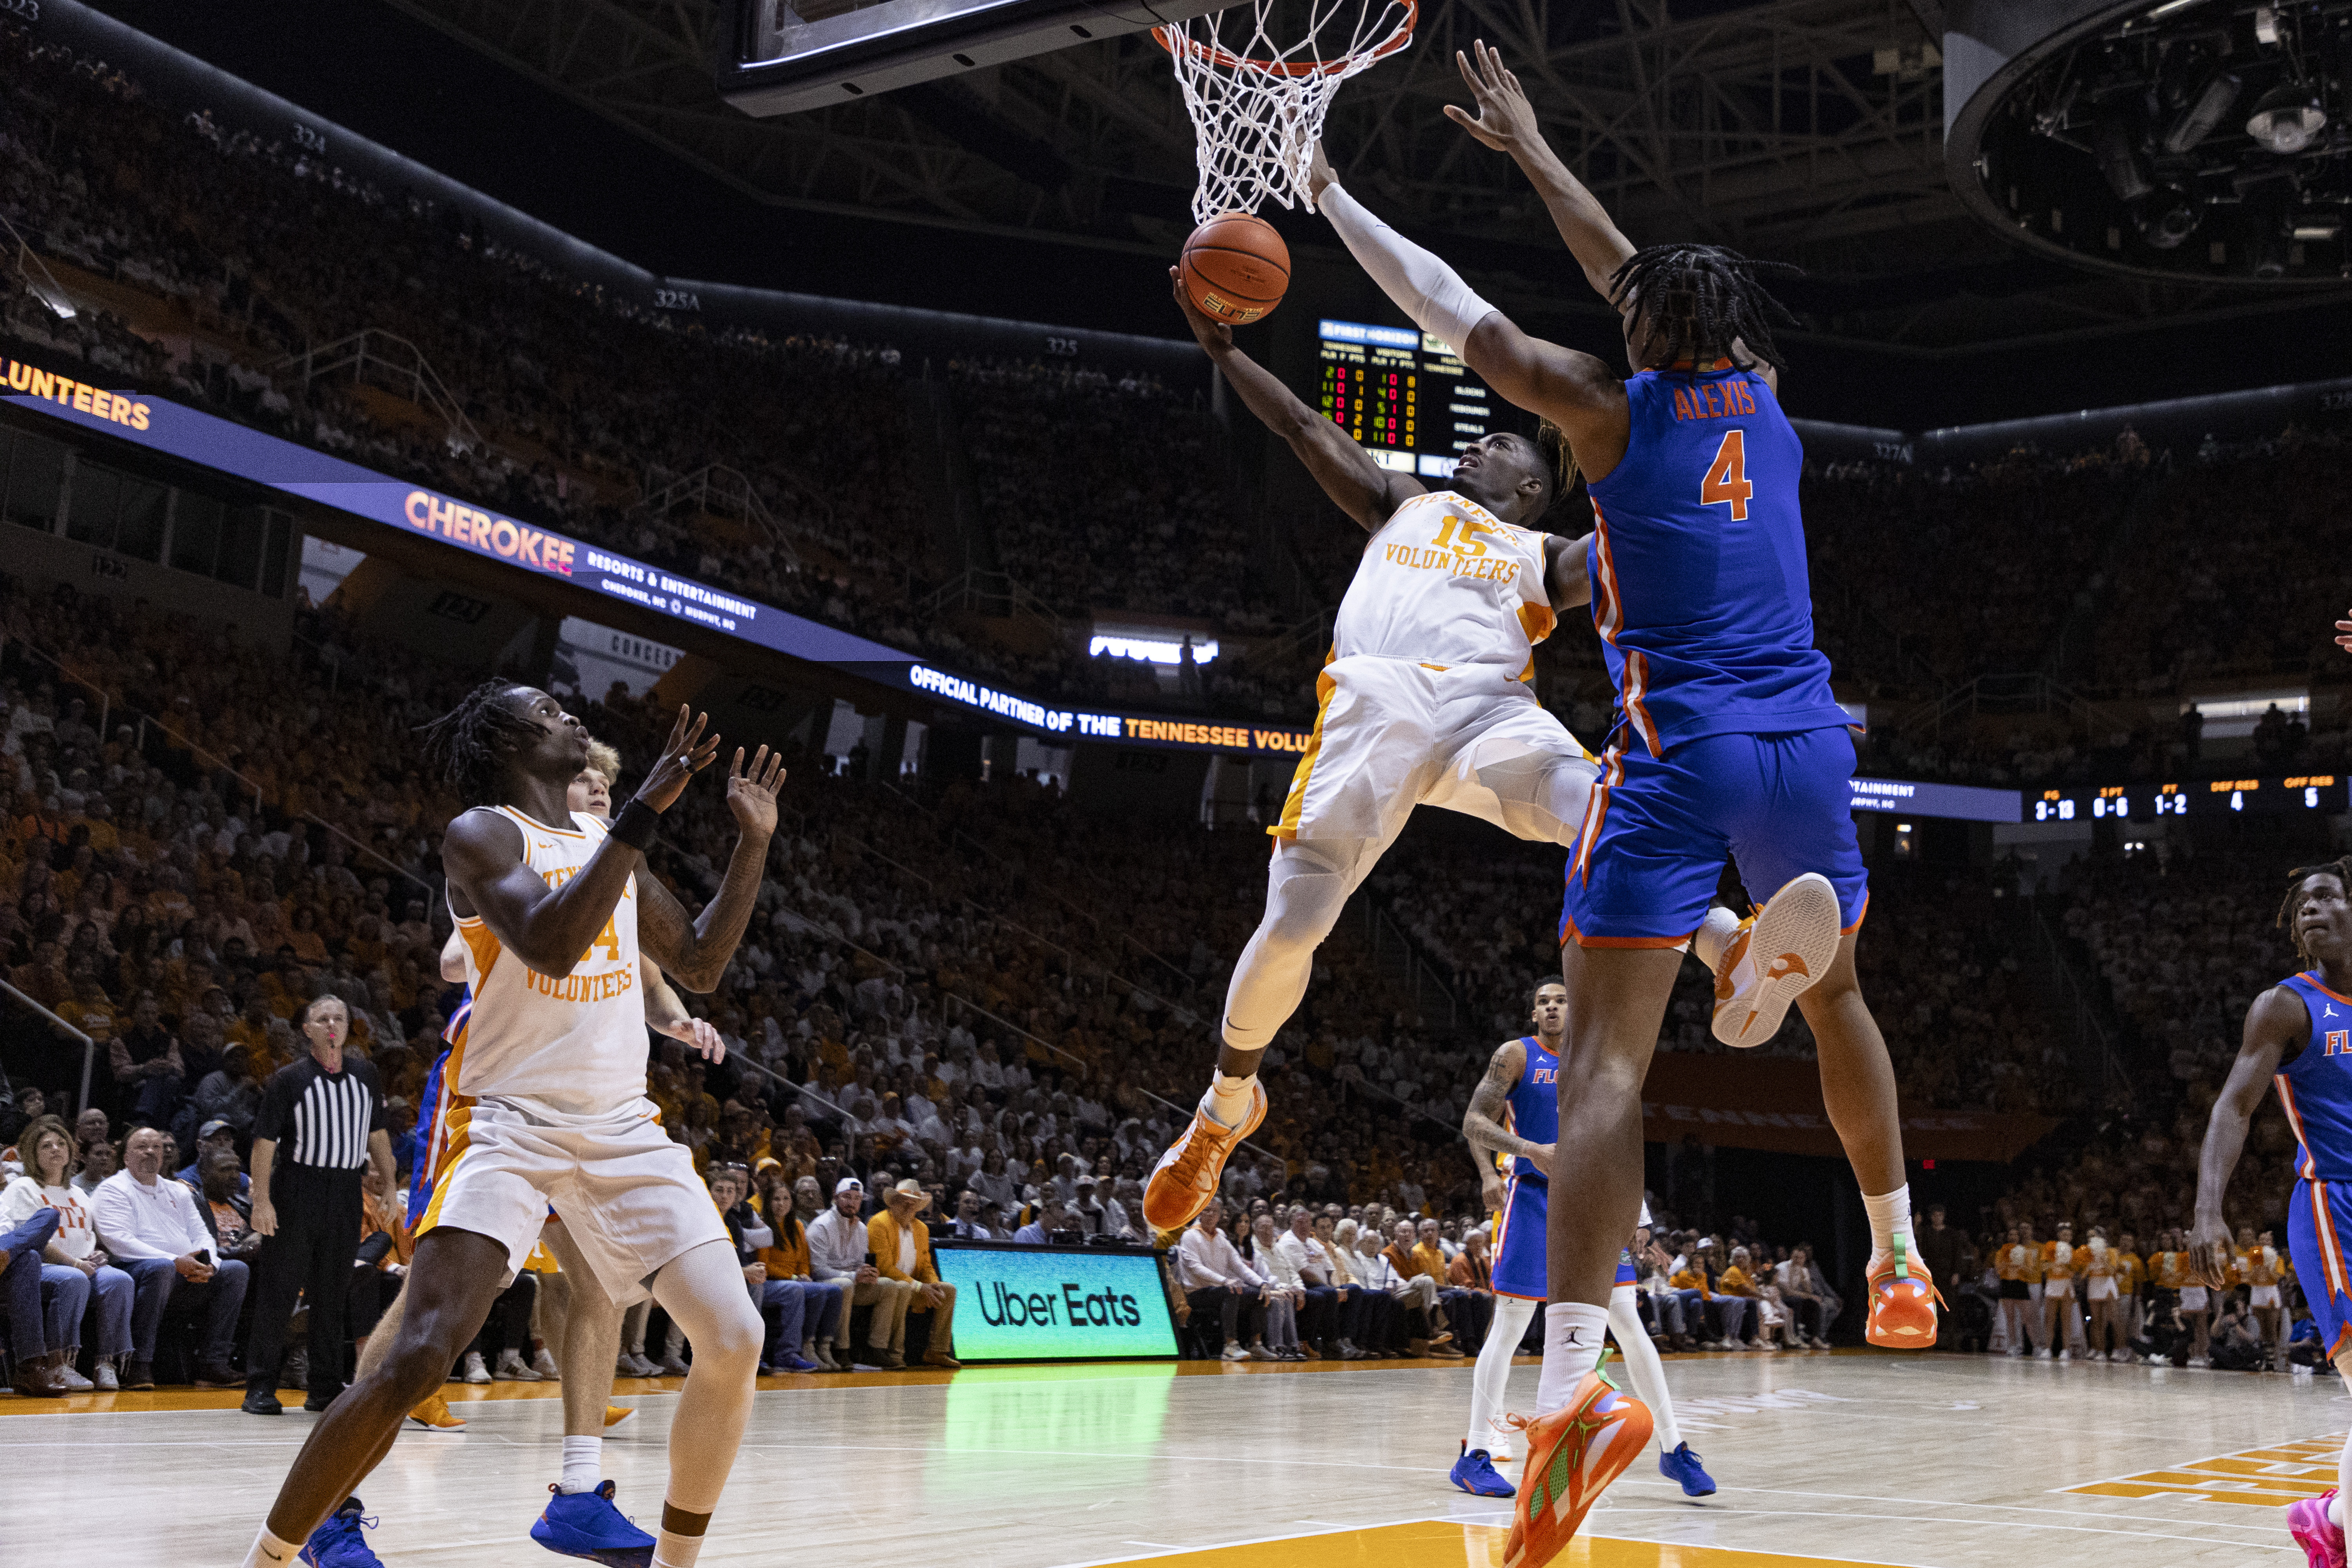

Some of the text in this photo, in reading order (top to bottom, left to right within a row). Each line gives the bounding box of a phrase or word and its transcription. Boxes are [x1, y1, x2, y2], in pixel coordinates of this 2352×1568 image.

[653, 288, 701, 312] 325A
[1326, 366, 1334, 378] 2
[1338, 367, 1346, 379] 0
[1389, 374, 1397, 385] 0
[1323, 381, 1364, 396] 11 0 1
[1377, 387, 1386, 399] 4
[1389, 388, 1397, 400] 0
[1336, 397, 1345, 409] 0
[1377, 401, 1386, 414] 5
[1392, 404, 1397, 414] 1
[1673, 381, 1756, 421] ALEXIS
[1336, 412, 1344, 424] 0
[1354, 413, 1363, 426] 2
[1374, 416, 1385, 429] 10
[1388, 417, 1396, 430] 0
[1454, 422, 1485, 435] STEALS
[1373, 431, 1385, 443] 11
[1387, 432, 1396, 444] 0
[1700, 429, 1753, 522] 4
[405, 491, 575, 577] CHEROKEE
[1431, 515, 1494, 557] 15
[1386, 543, 1520, 584] VOLUNTEERS
[587, 551, 757, 620] RESORTS & ENTERTAINMENT
[601, 579, 736, 631] CHEROKEE, NC MURPHY, NC
[910, 664, 978, 705] OFFICIAL
[980, 687, 1045, 727] PARTNER
[1046, 710, 1074, 732] OF
[1077, 713, 1122, 737] THE
[1125, 718, 1249, 748] TENNESSEE
[2210, 775, 2334, 792] DEF REB OFF REB
[2230, 786, 2319, 812] 4 5
[976, 1281, 1141, 1327] Uber Eats
